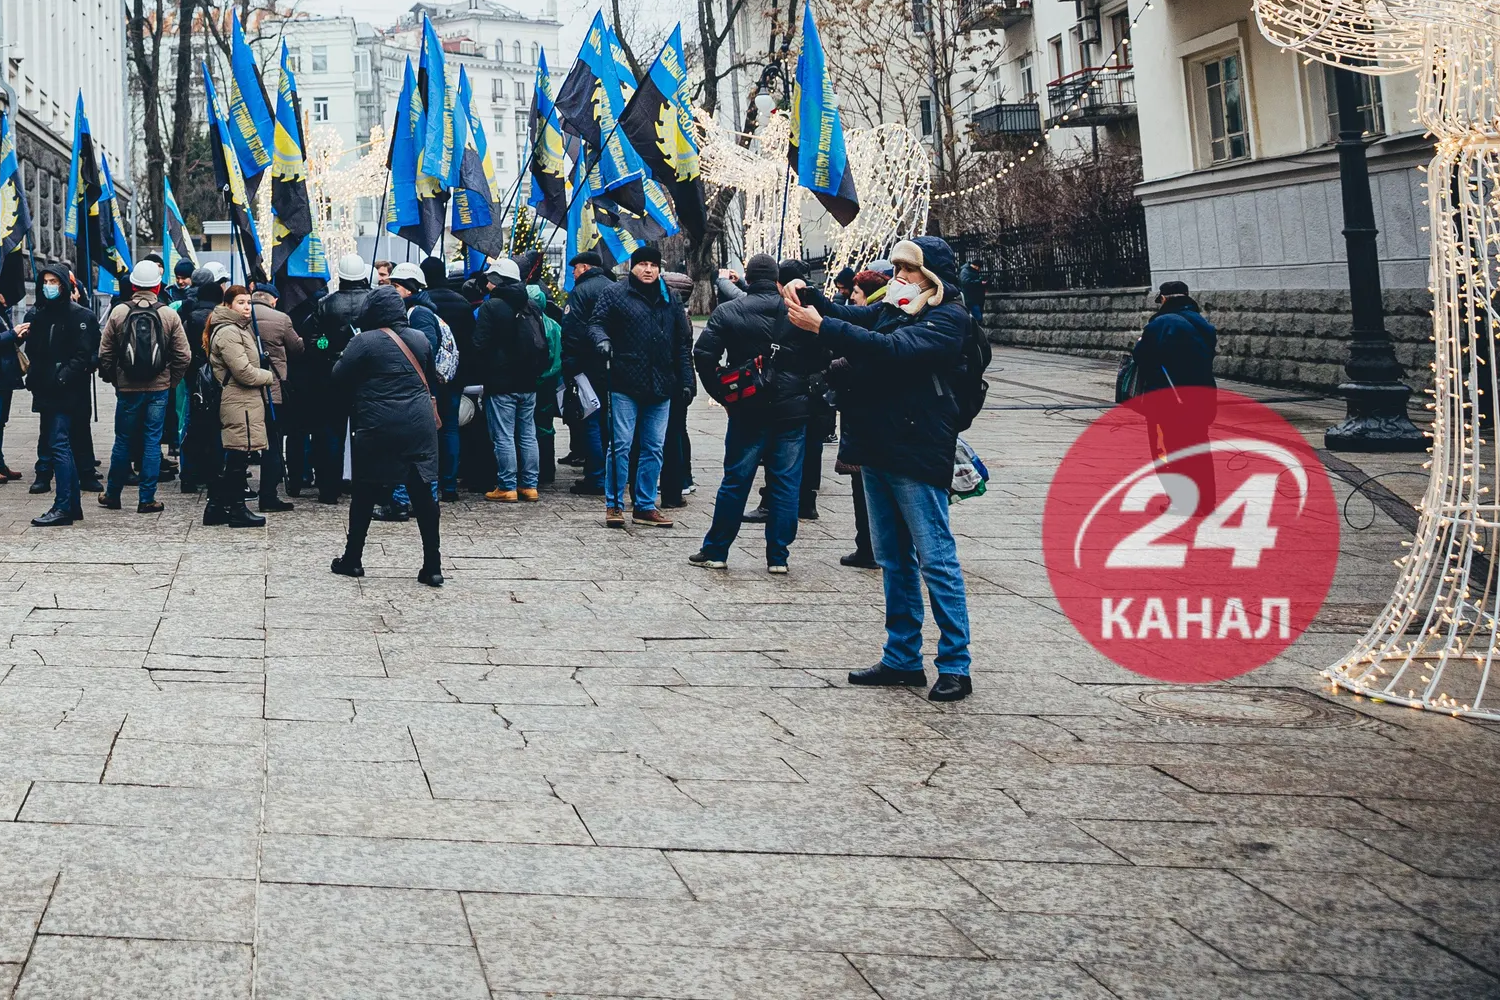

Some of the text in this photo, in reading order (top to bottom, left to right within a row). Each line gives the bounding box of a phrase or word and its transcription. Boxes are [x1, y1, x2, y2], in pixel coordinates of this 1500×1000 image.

[231, 101, 258, 139] ГІРНИКІВ
[246, 134, 271, 167] УКРАЇНИ
[456, 192, 473, 225] УКРАЇНИ
